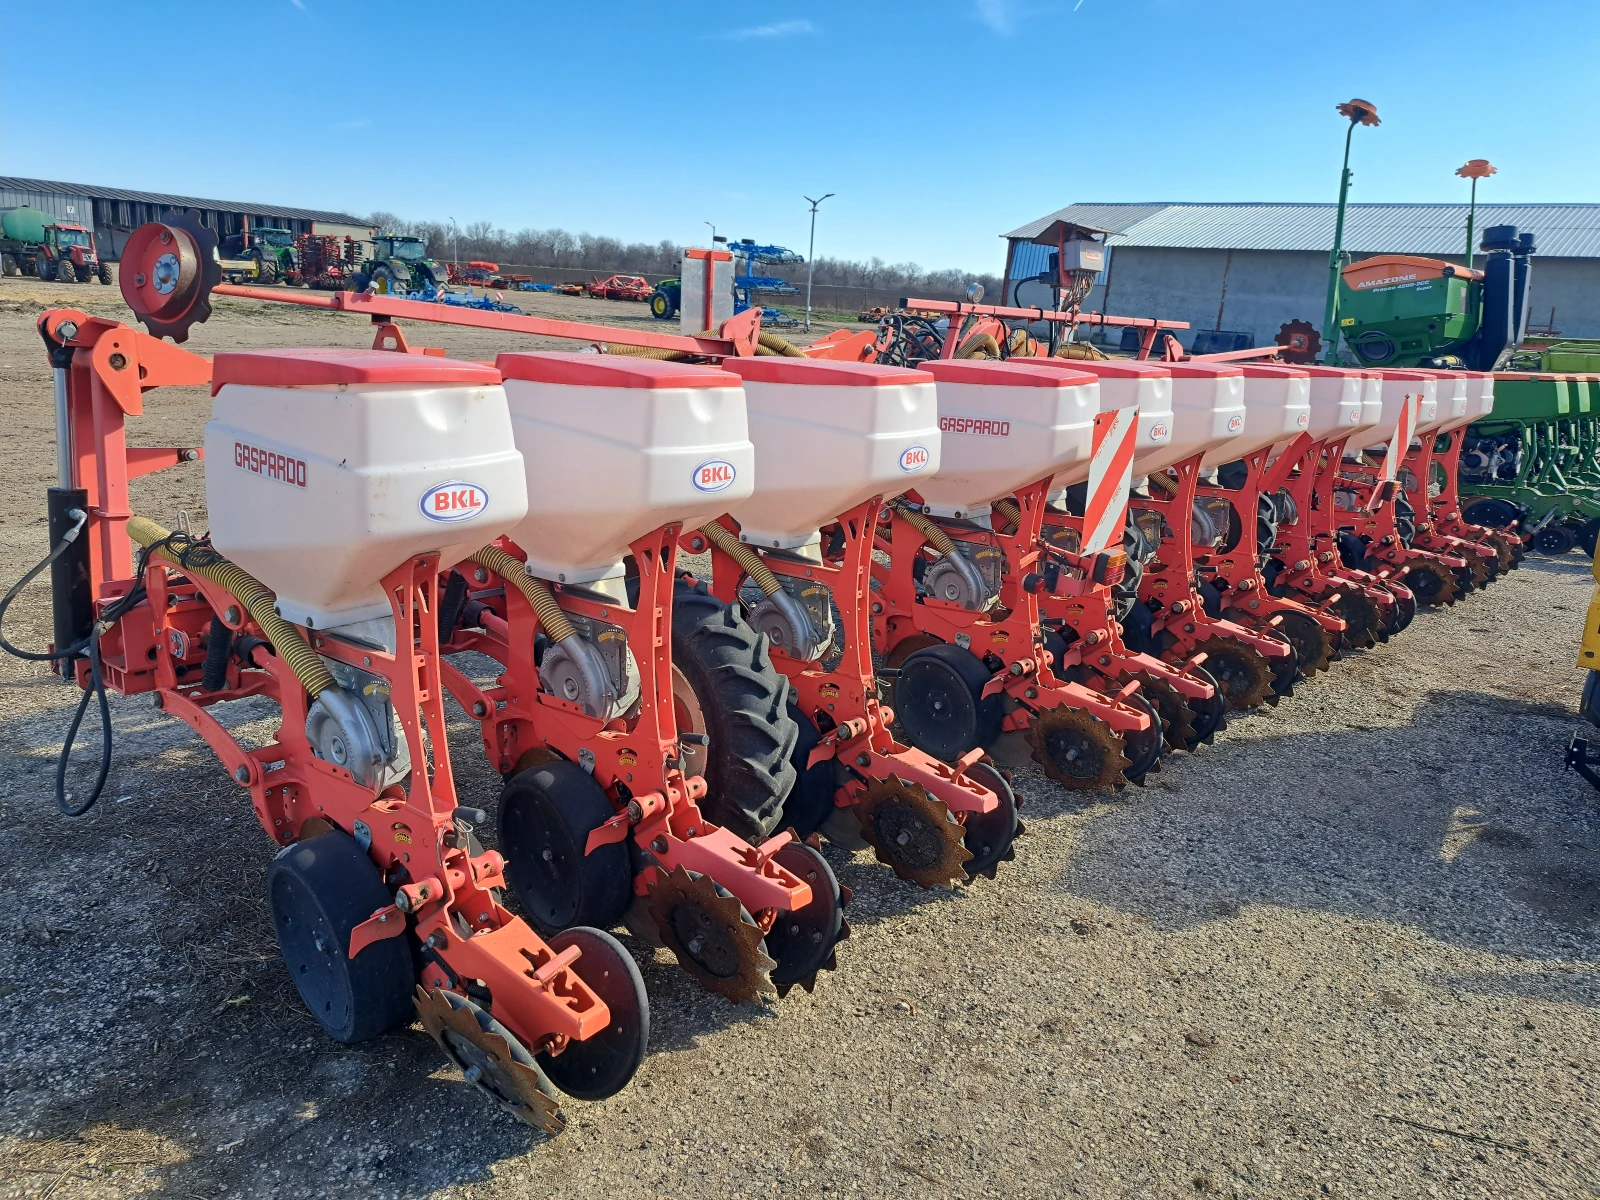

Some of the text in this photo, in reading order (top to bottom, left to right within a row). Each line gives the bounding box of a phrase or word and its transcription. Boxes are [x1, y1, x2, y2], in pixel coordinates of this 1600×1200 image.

[1357, 273, 1417, 289] AMAZONE
[940, 417, 1010, 437] GASPARDO
[1154, 426, 1164, 437] BKL
[234, 441, 306, 488] GASPARDO
[905, 450, 926, 465] BKL
[701, 465, 732, 484] BKL
[434, 489, 481, 512] BKL
